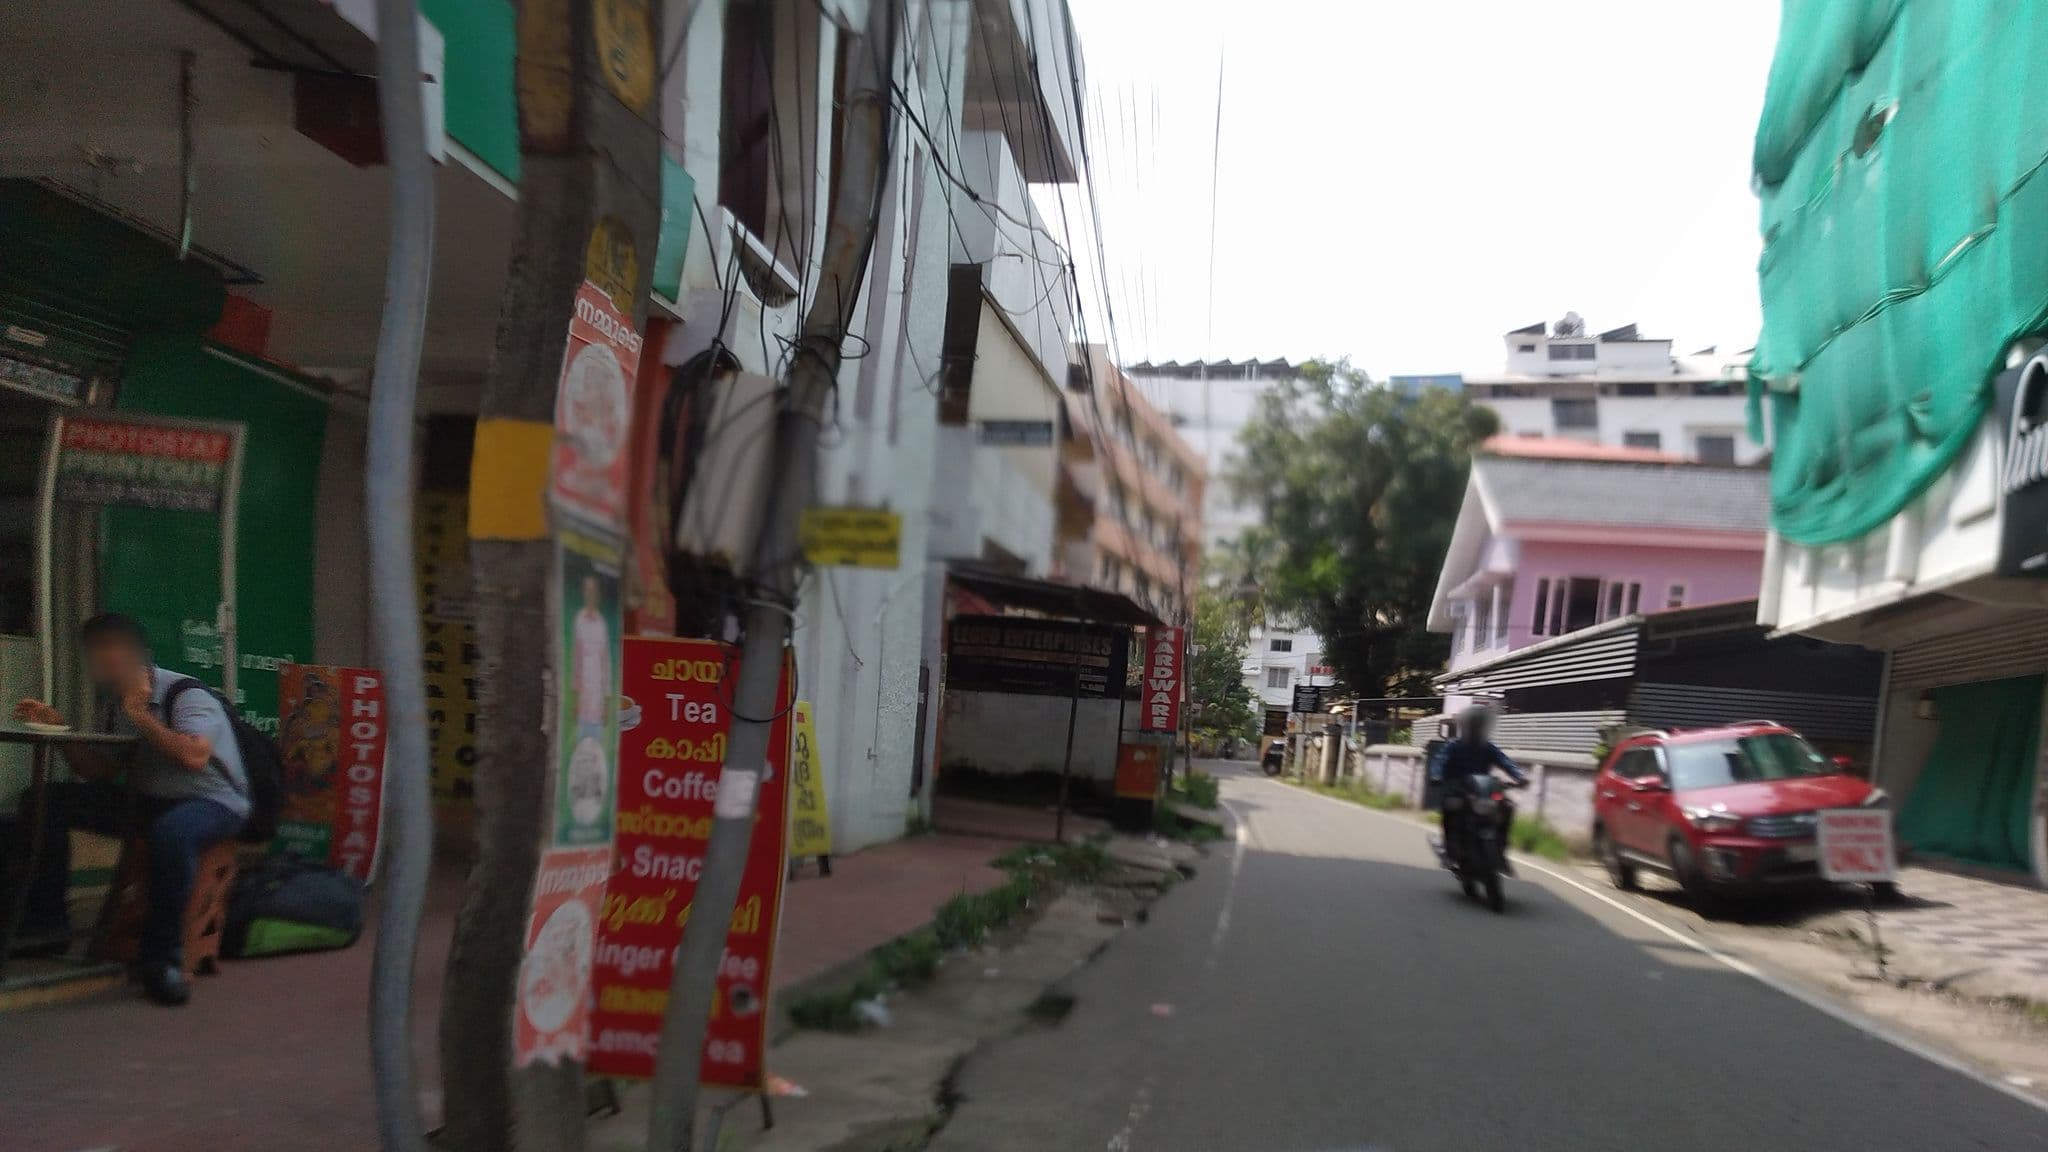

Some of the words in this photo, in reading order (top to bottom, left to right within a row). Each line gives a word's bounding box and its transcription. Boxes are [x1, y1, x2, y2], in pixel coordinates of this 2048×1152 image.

[1149, 630, 1176, 729] HARDWARE
[665, 693, 718, 724] Tea
[343, 675, 379, 875] PHOTOSTAT
[642, 768, 722, 800] Coffe
[631, 845, 702, 882] Snac
[591, 936, 666, 977] inger
